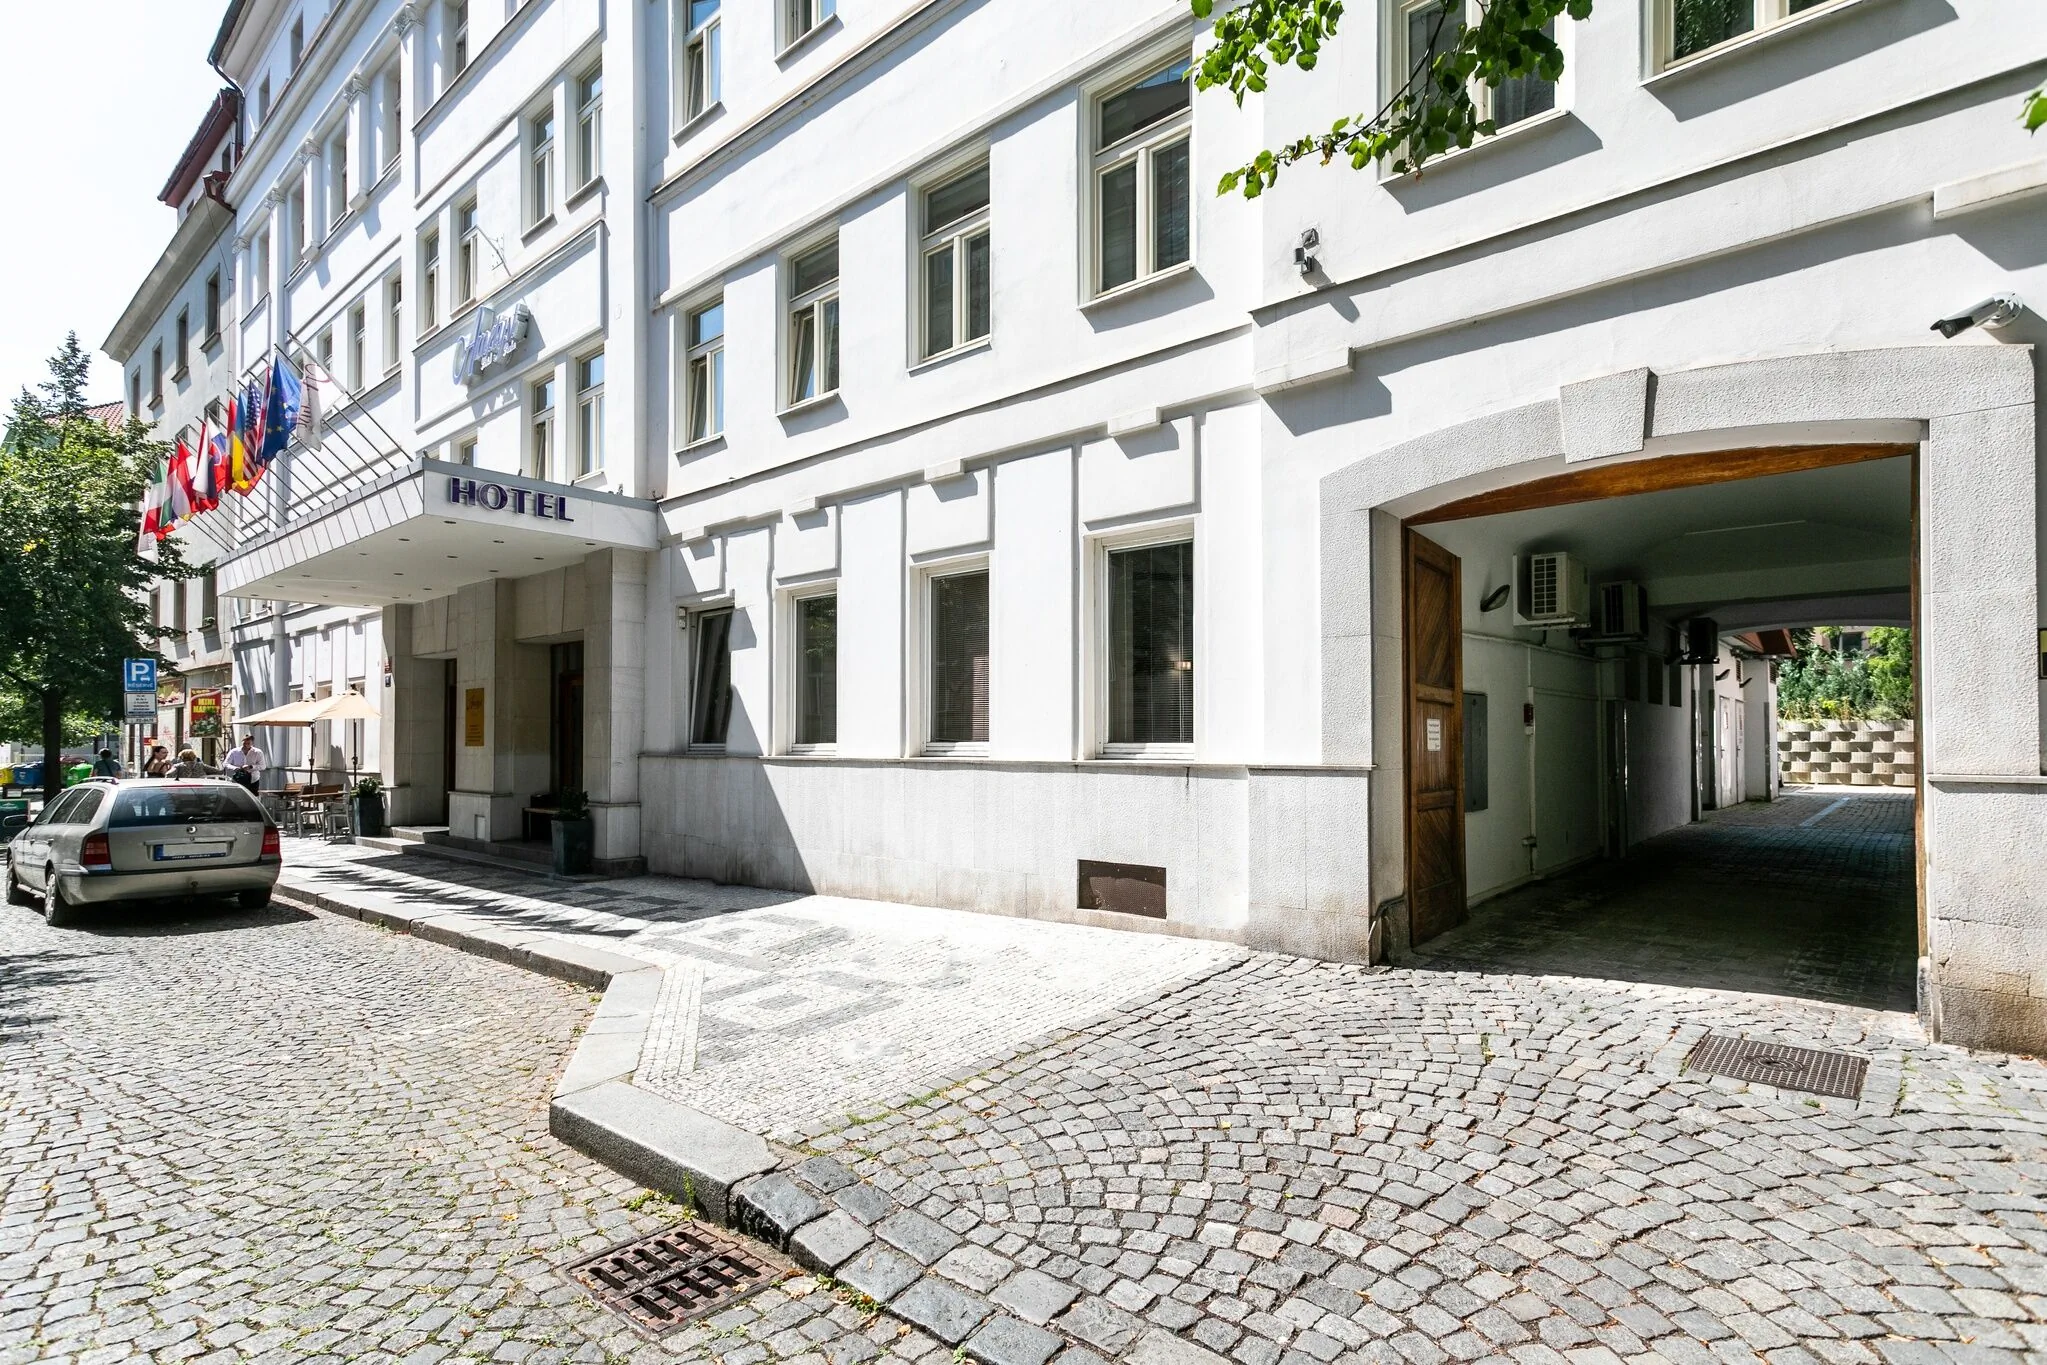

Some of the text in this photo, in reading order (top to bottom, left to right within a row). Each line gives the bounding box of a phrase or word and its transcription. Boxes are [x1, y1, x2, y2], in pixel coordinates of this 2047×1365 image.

[450, 477, 574, 522] HOTEL
[131, 662, 150, 681] P
[198, 698, 216, 706] MINI
